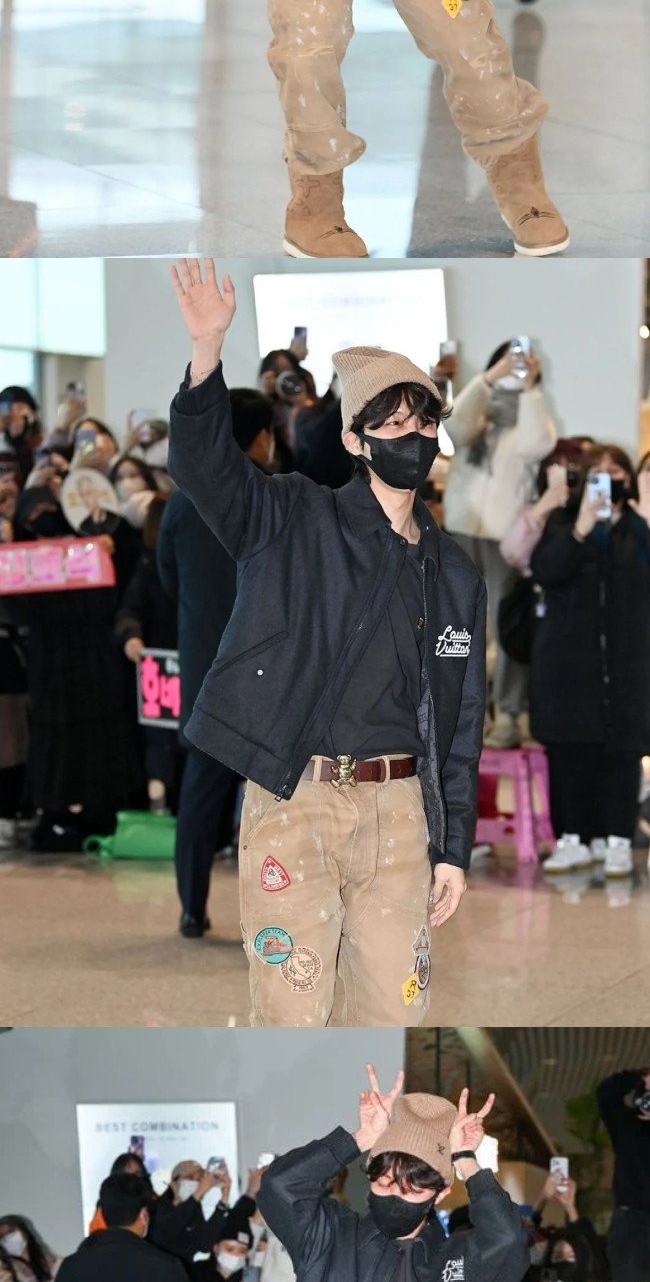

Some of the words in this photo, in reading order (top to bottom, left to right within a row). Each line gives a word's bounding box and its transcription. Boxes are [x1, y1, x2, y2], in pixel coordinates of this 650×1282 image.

[438, 625, 471, 642] Louis
[435, 641, 470, 657] Vuitton
[95, 1122, 126, 1133] BEST
[131, 1121, 219, 1132] COMBINATION
